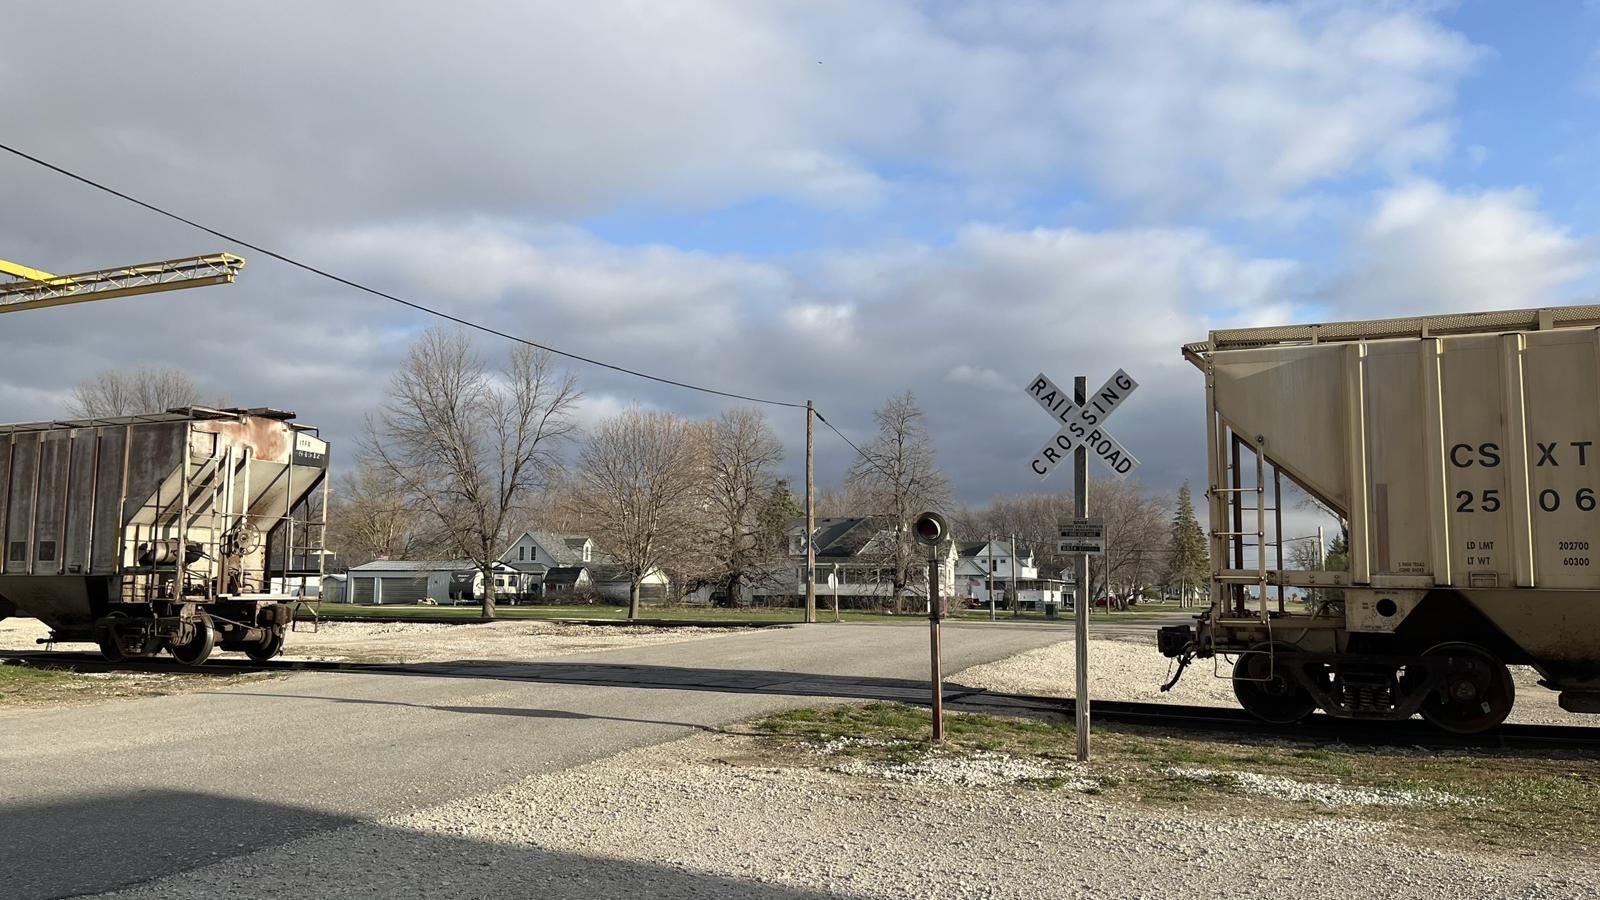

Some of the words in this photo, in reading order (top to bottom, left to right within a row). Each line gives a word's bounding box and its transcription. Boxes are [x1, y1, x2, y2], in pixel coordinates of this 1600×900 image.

[1031, 375, 1132, 475] CROSSING
[1466, 541, 1476, 550] LD
[1479, 541, 1494, 550] LMT
[1558, 541, 1590, 551] 202700
[1467, 557, 1475, 565] LT
[1477, 557, 1491, 565] WT
[1563, 558, 1590, 566] 60300
